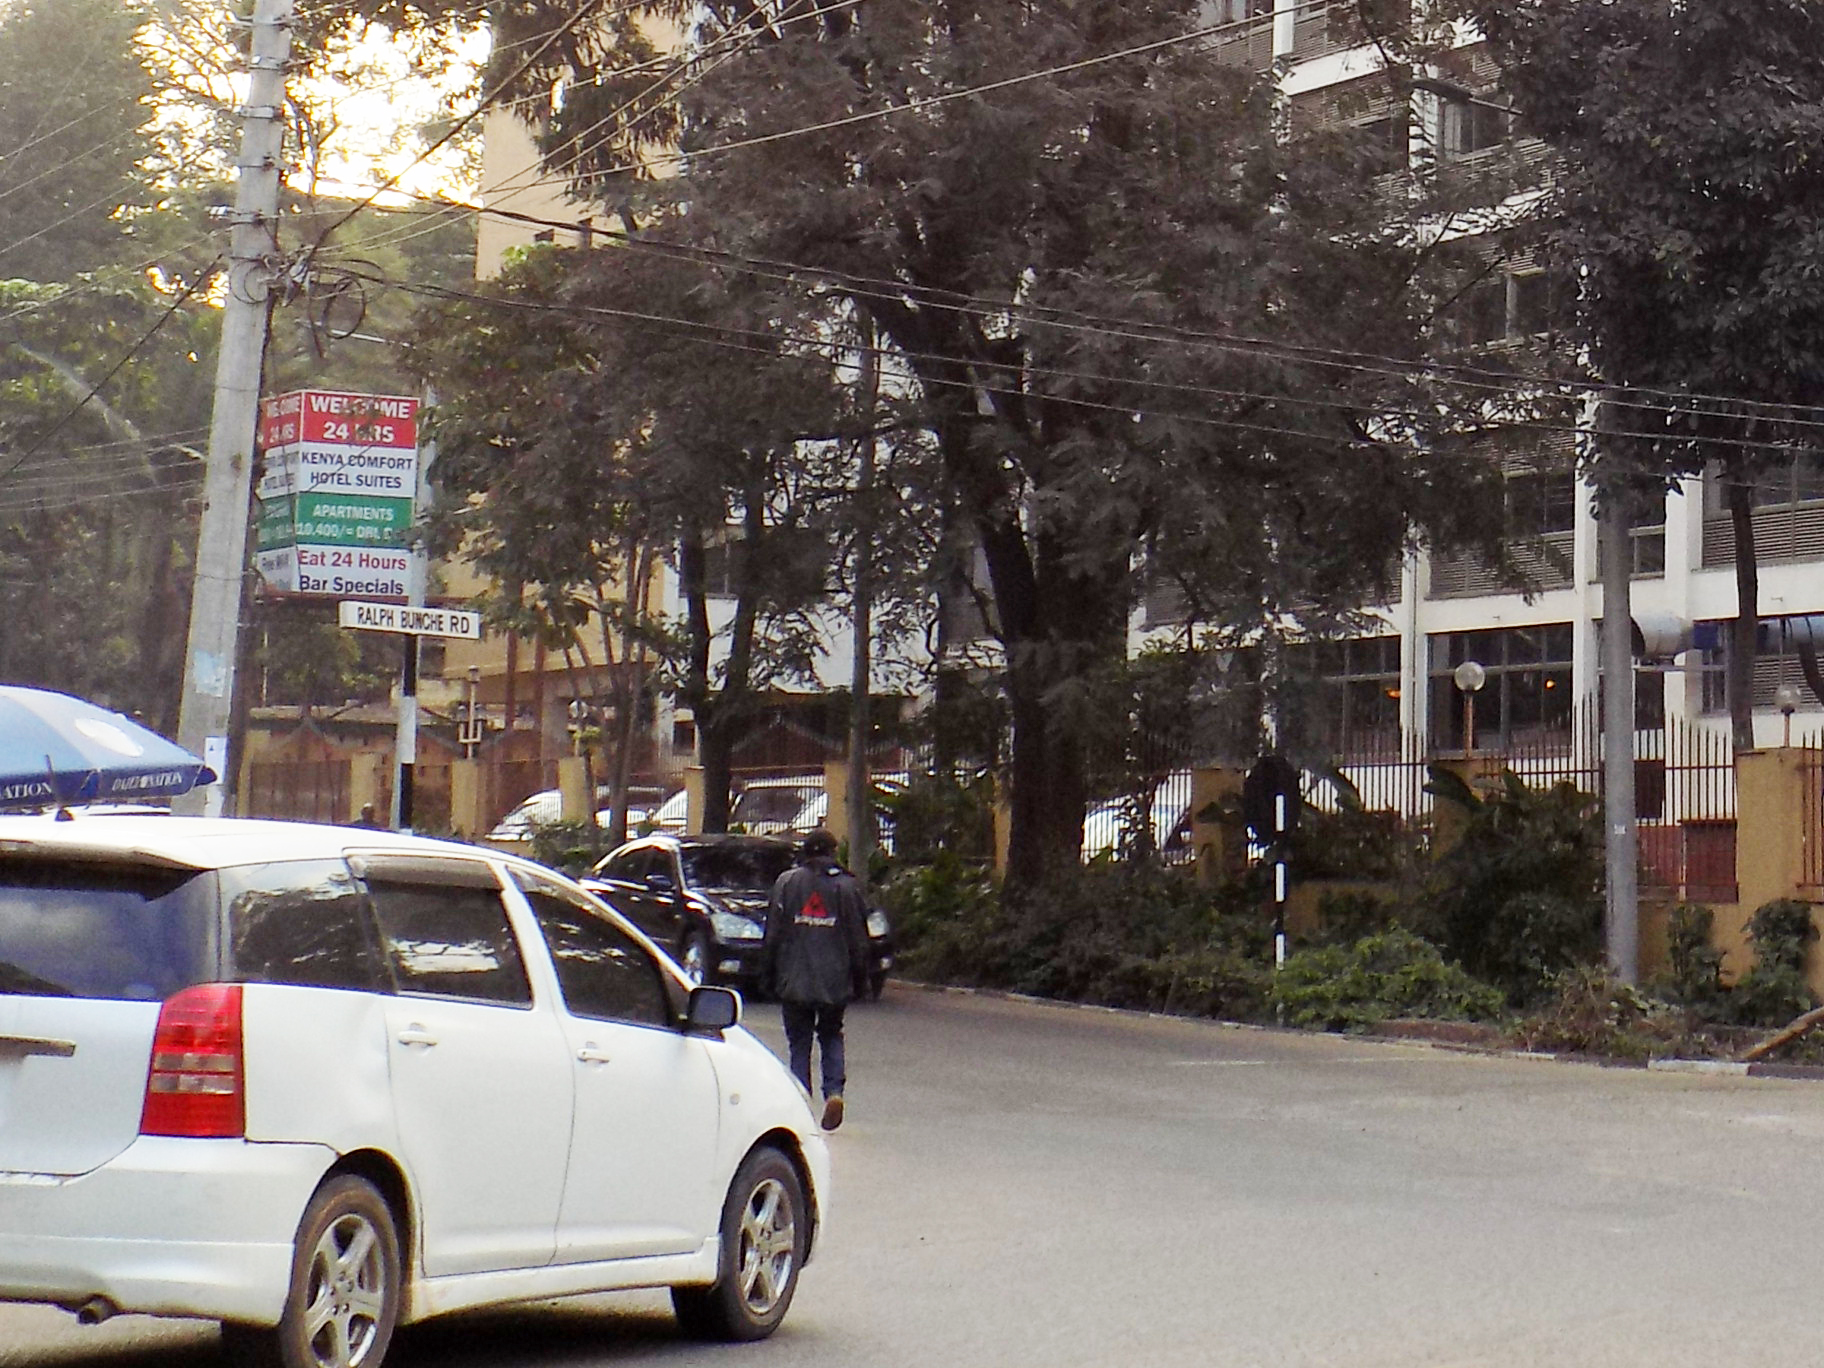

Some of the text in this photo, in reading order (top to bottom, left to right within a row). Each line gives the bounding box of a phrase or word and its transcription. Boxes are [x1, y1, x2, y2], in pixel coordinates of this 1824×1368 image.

[323, 421, 350, 440] 24
[301, 451, 344, 466] KENYA
[348, 454, 413, 470] COMFORT
[310, 471, 352, 486] HOTEL
[356, 474, 402, 489] SUITES
[312, 503, 394, 521] APARTMENTS
[298, 549, 326, 567] Eat
[331, 551, 353, 568] 24
[359, 553, 407, 571] Hours
[300, 574, 328, 591] Bar
[332, 576, 404, 595] Specials
[357, 606, 470, 634] RALPH BUNCHE RD
[0, 782, 52, 799] ATION
